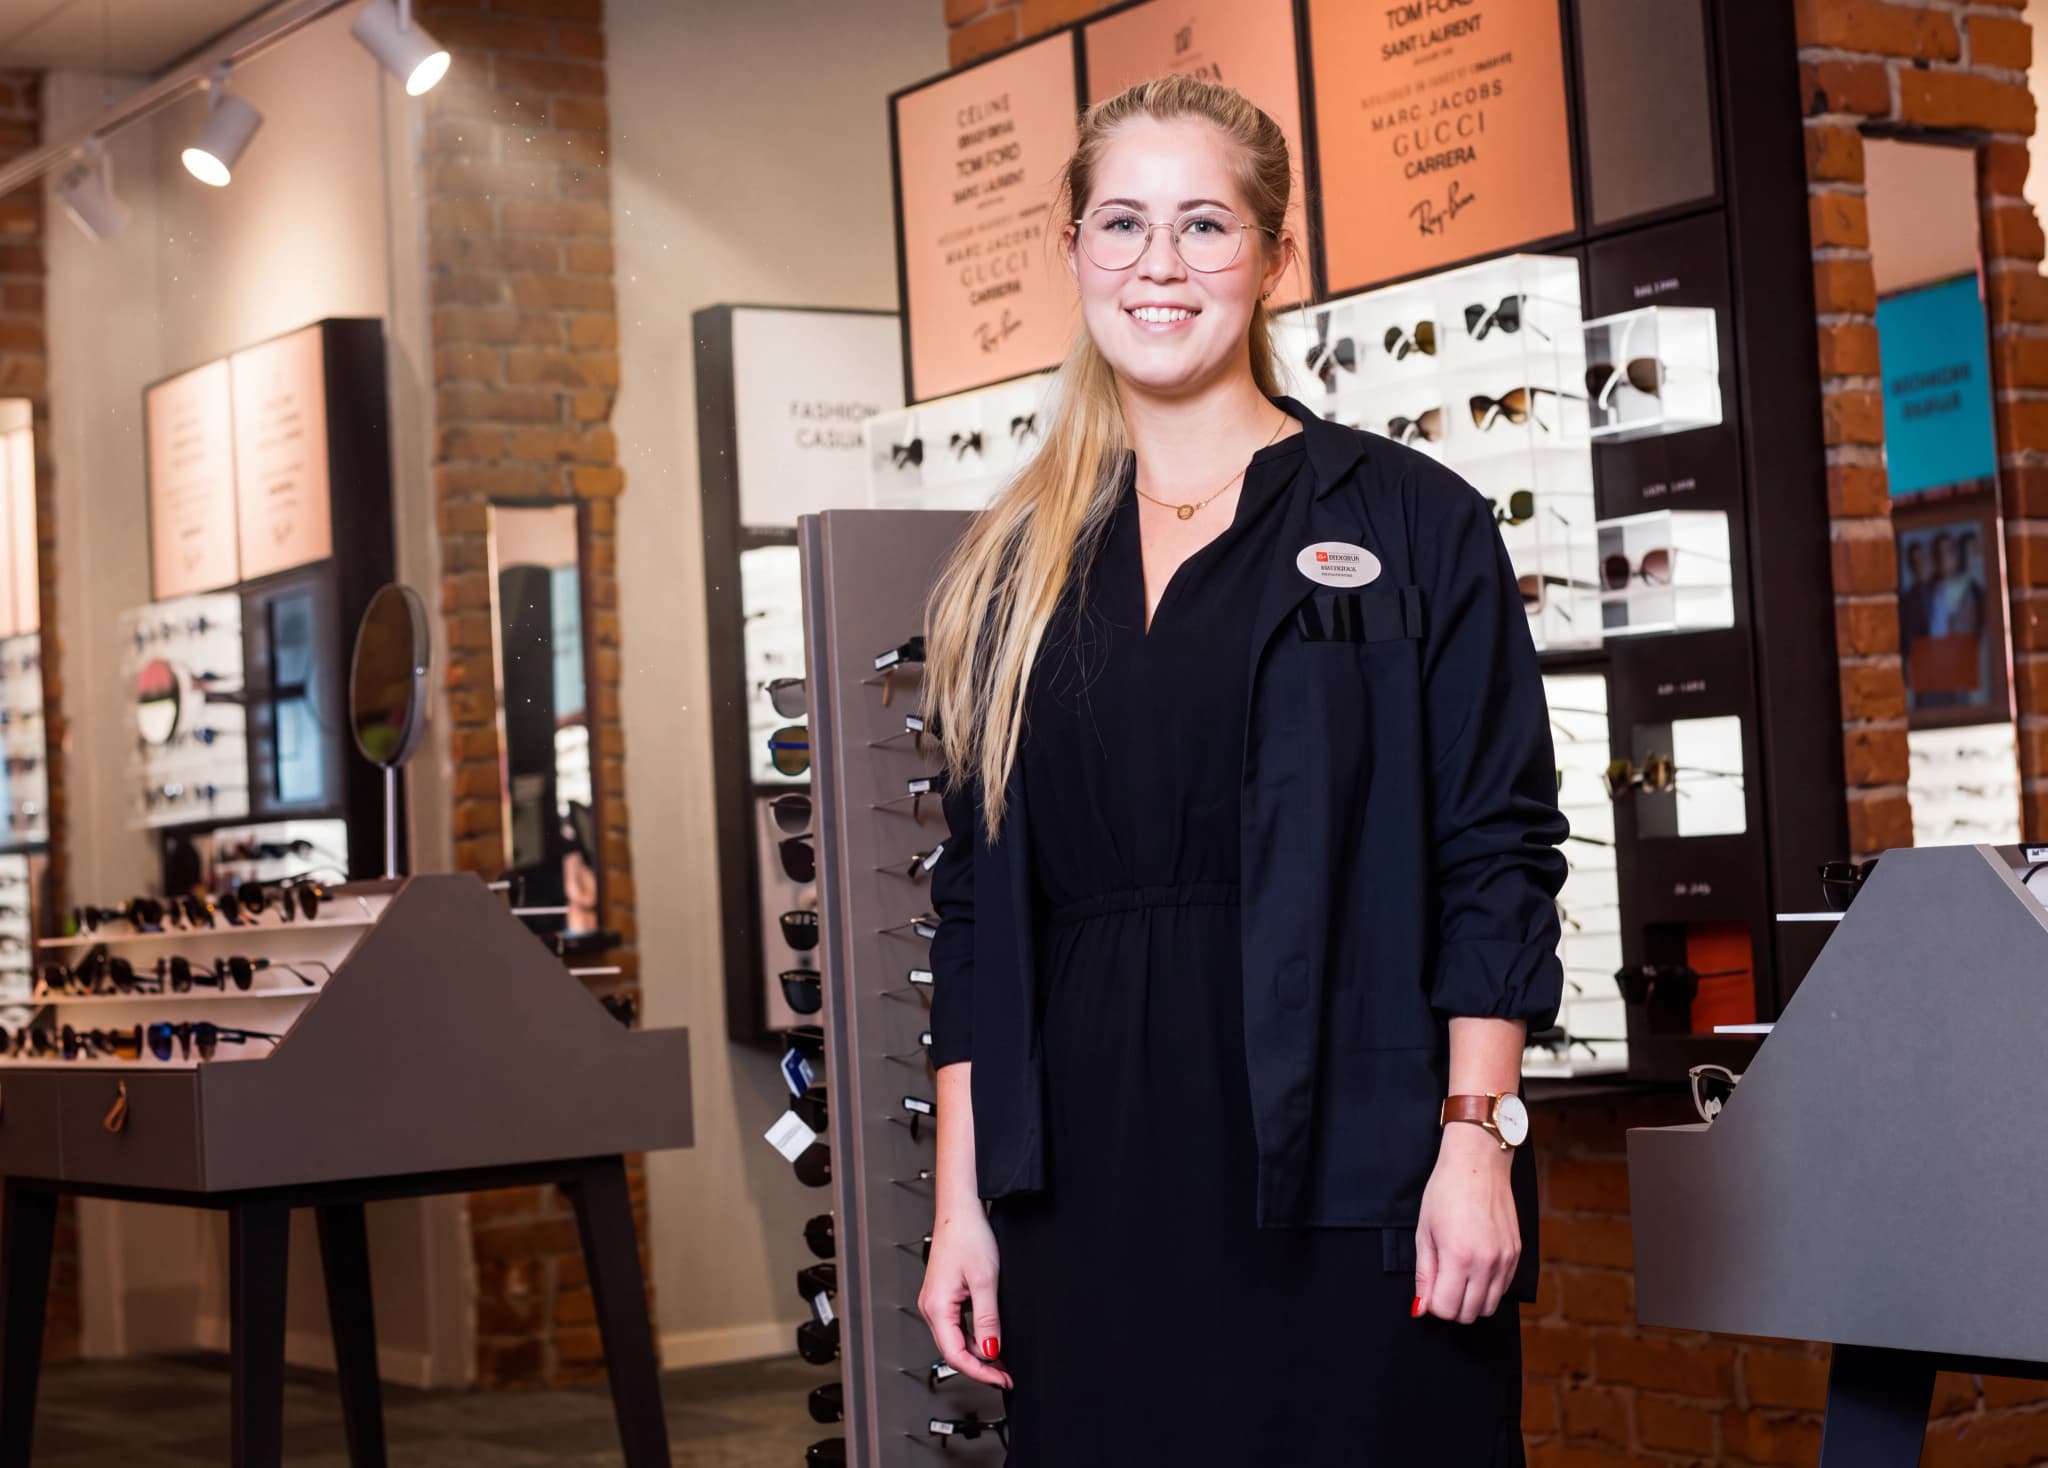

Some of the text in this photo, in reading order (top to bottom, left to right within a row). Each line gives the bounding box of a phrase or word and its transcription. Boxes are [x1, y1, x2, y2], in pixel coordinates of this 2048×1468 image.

[1386, 2, 1423, 30] TOM
[1381, 35, 1417, 61] SAINT
[1420, 13, 1482, 48] LAURENT
[1371, 104, 1421, 131] MARC
[1429, 79, 1503, 116] JACOBS
[1392, 110, 1485, 157] GUCCI
[1404, 145, 1476, 179] CARRERA
[795, 428, 865, 450] CASUA
